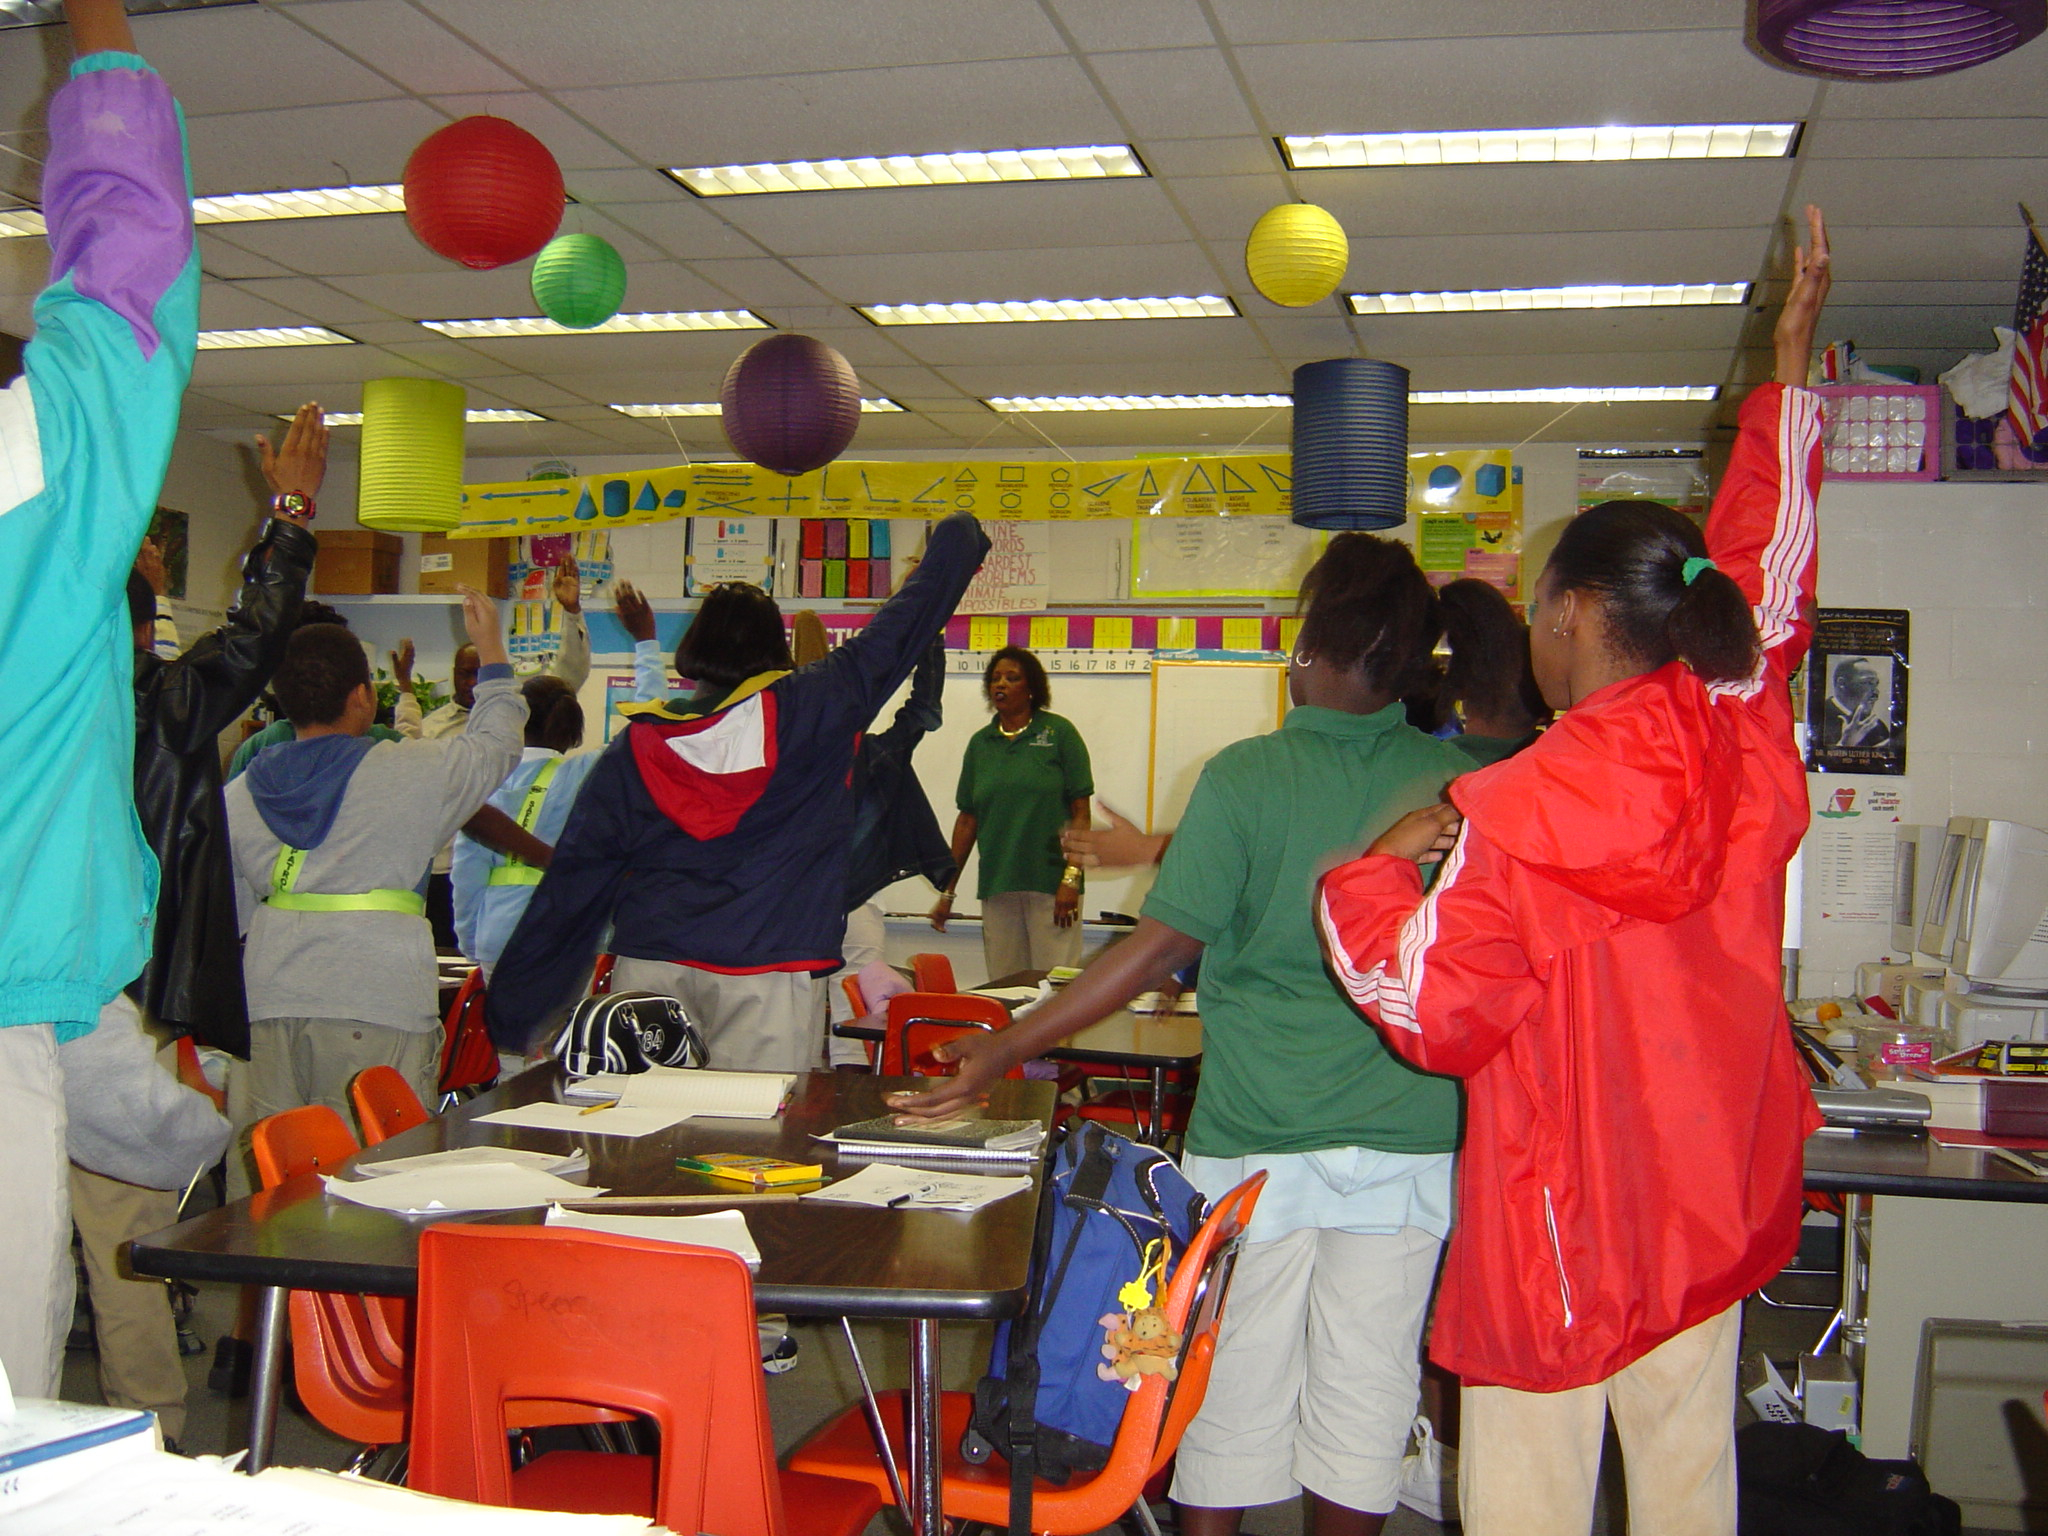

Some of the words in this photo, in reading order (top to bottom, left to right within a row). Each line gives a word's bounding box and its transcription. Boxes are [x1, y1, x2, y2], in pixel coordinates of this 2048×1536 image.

[990, 537, 1026, 554] ORDS
[974, 568, 1036, 586] ROBLEMS
[958, 660, 968, 671] 10
[1051, 660, 1062, 670] 15
[1069, 660, 1080, 670] 16
[1087, 659, 1098, 670] 17
[1106, 660, 1117, 670] 18
[1125, 659, 1137, 670] 19
[643, 1028, 663, 1053] 84
